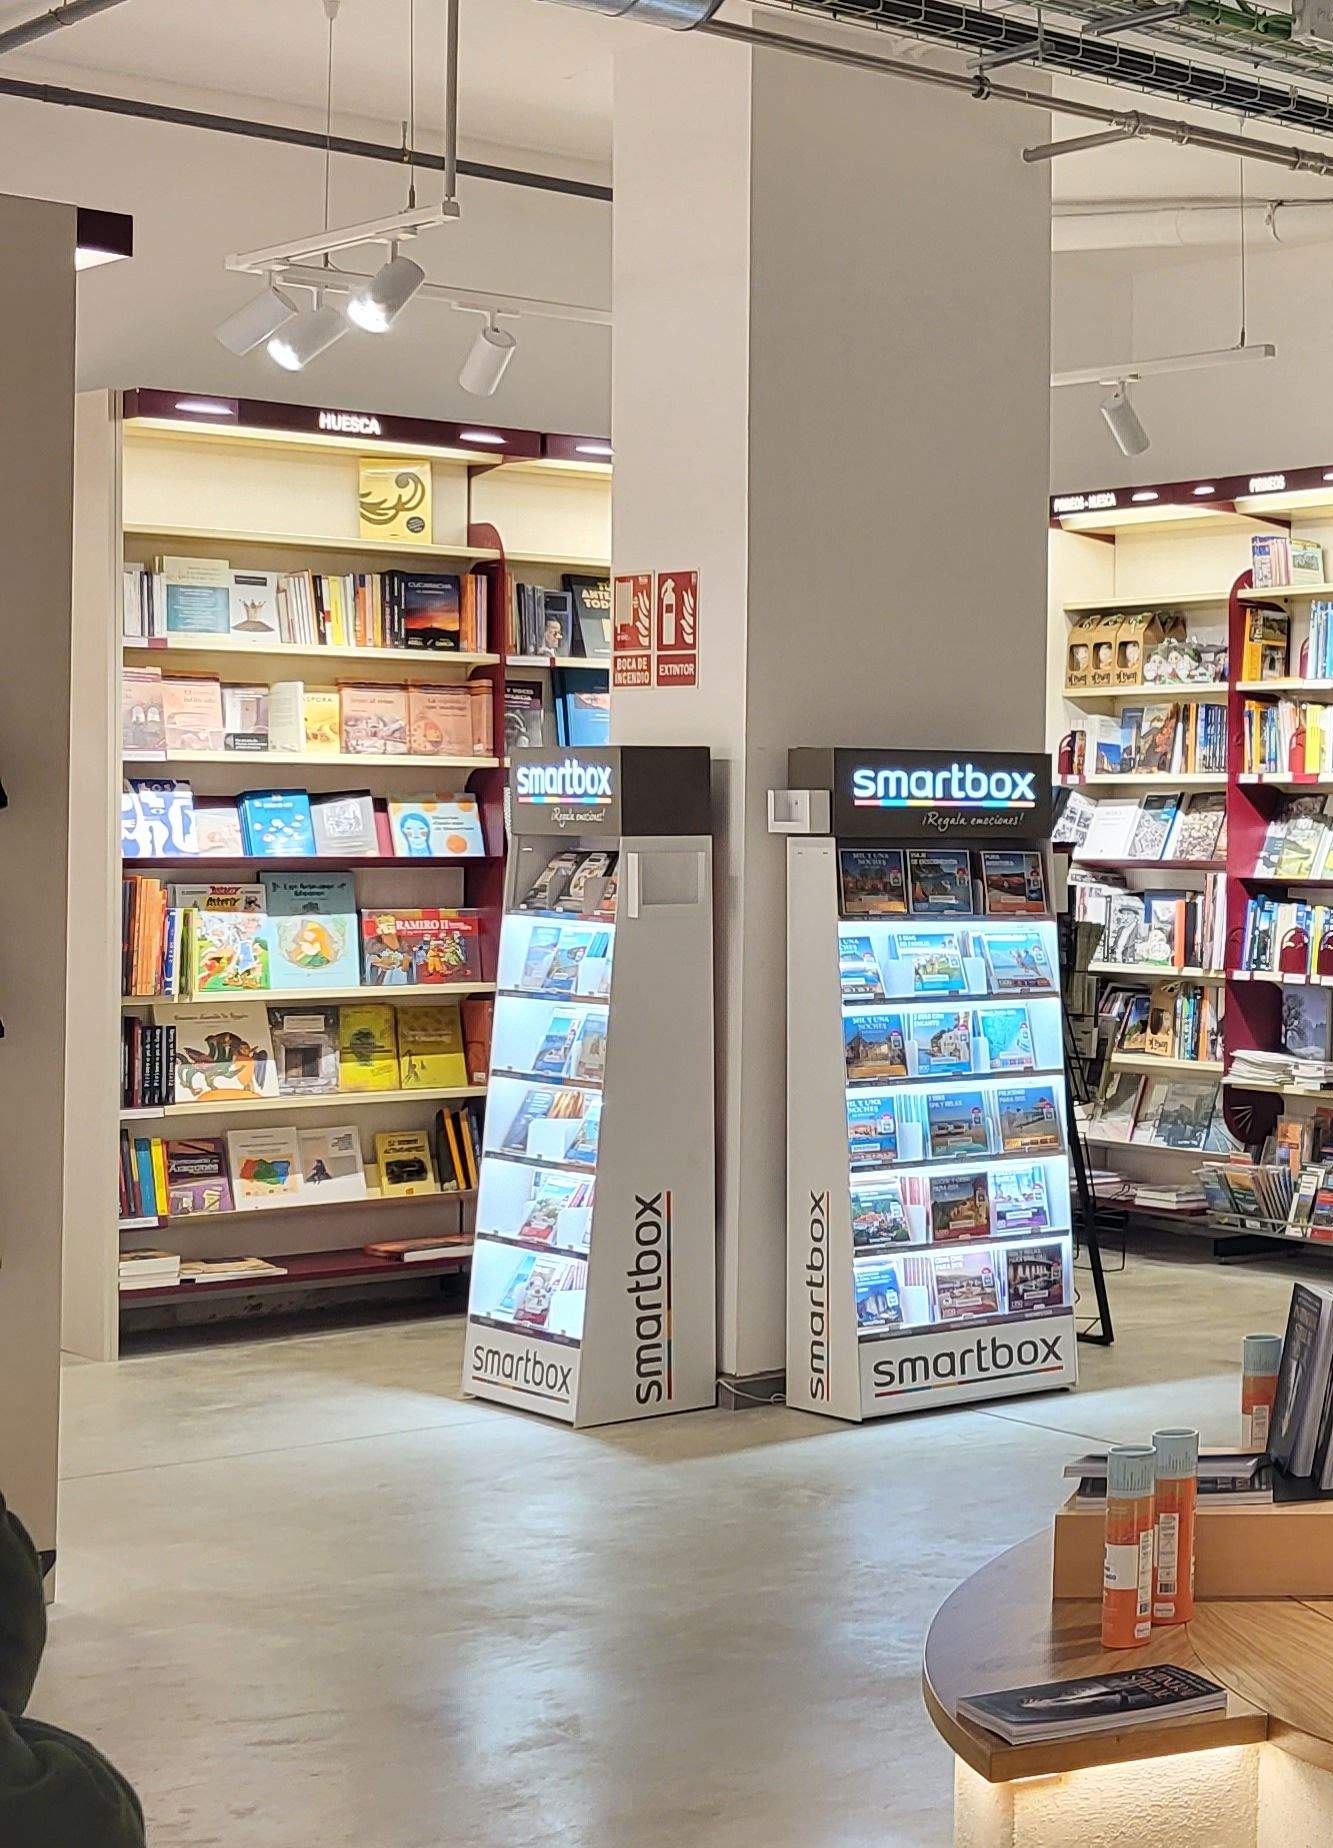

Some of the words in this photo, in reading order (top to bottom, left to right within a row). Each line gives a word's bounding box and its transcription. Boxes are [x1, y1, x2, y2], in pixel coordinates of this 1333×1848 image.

[318, 411, 381, 435] HUESCA
[615, 671, 650, 685] INCENDIO
[616, 657, 635, 671] BOCA
[635, 657, 648, 671] DE
[659, 663, 695, 677] EXTINTOR
[516, 758, 612, 796] smartbox
[853, 763, 1036, 800] smartbox
[922, 811, 967, 832] ¡Regala
[971, 812, 1025, 827] emociones!
[395, 919, 439, 930] RAMIRO
[440, 919, 449, 930] II
[627, 1192, 662, 1405] smartbox
[809, 1190, 826, 1401] smartbox
[471, 1344, 573, 1396] smartbox
[872, 1335, 1063, 1388] smartbox
